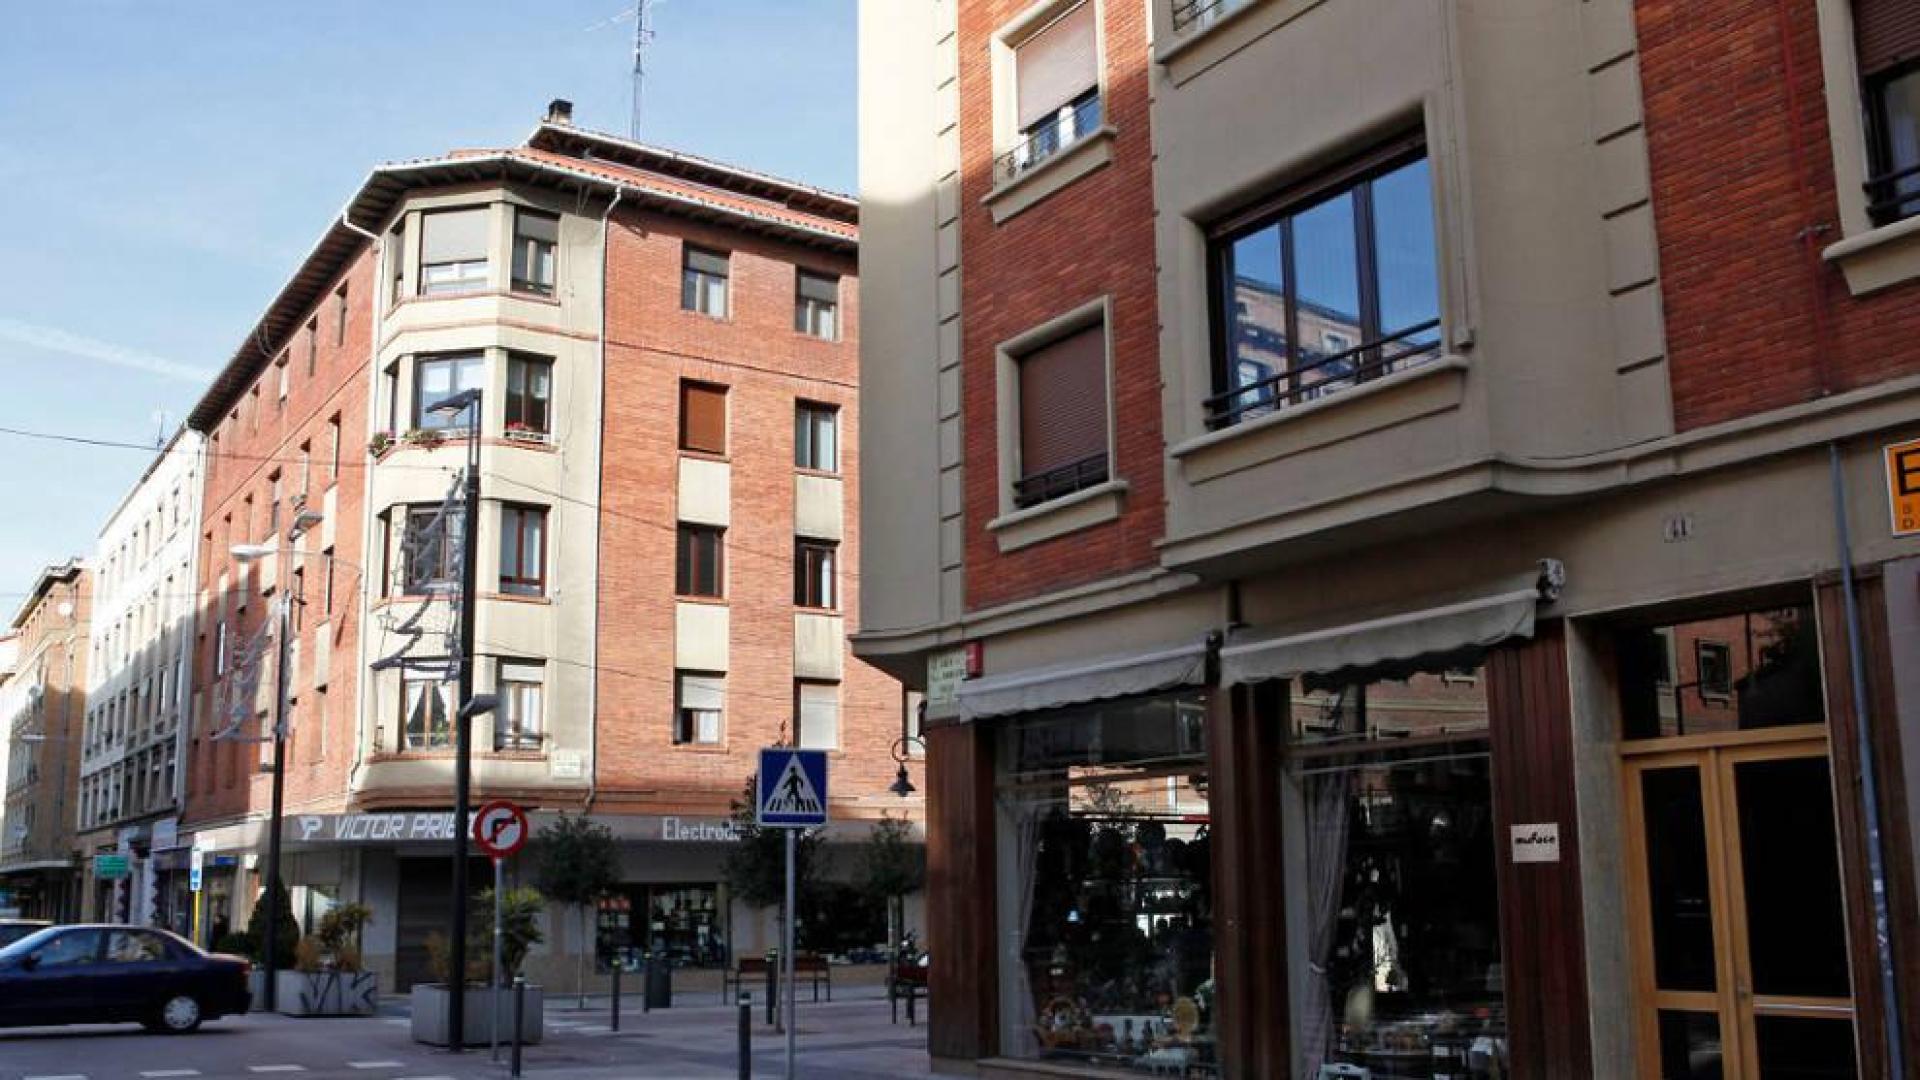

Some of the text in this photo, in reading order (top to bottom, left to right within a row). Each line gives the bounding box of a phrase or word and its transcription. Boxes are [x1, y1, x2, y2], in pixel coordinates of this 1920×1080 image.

[335, 814, 405, 839] VICTOR
[409, 813, 477, 839] PRIE
[662, 816, 741, 841] Electrod
